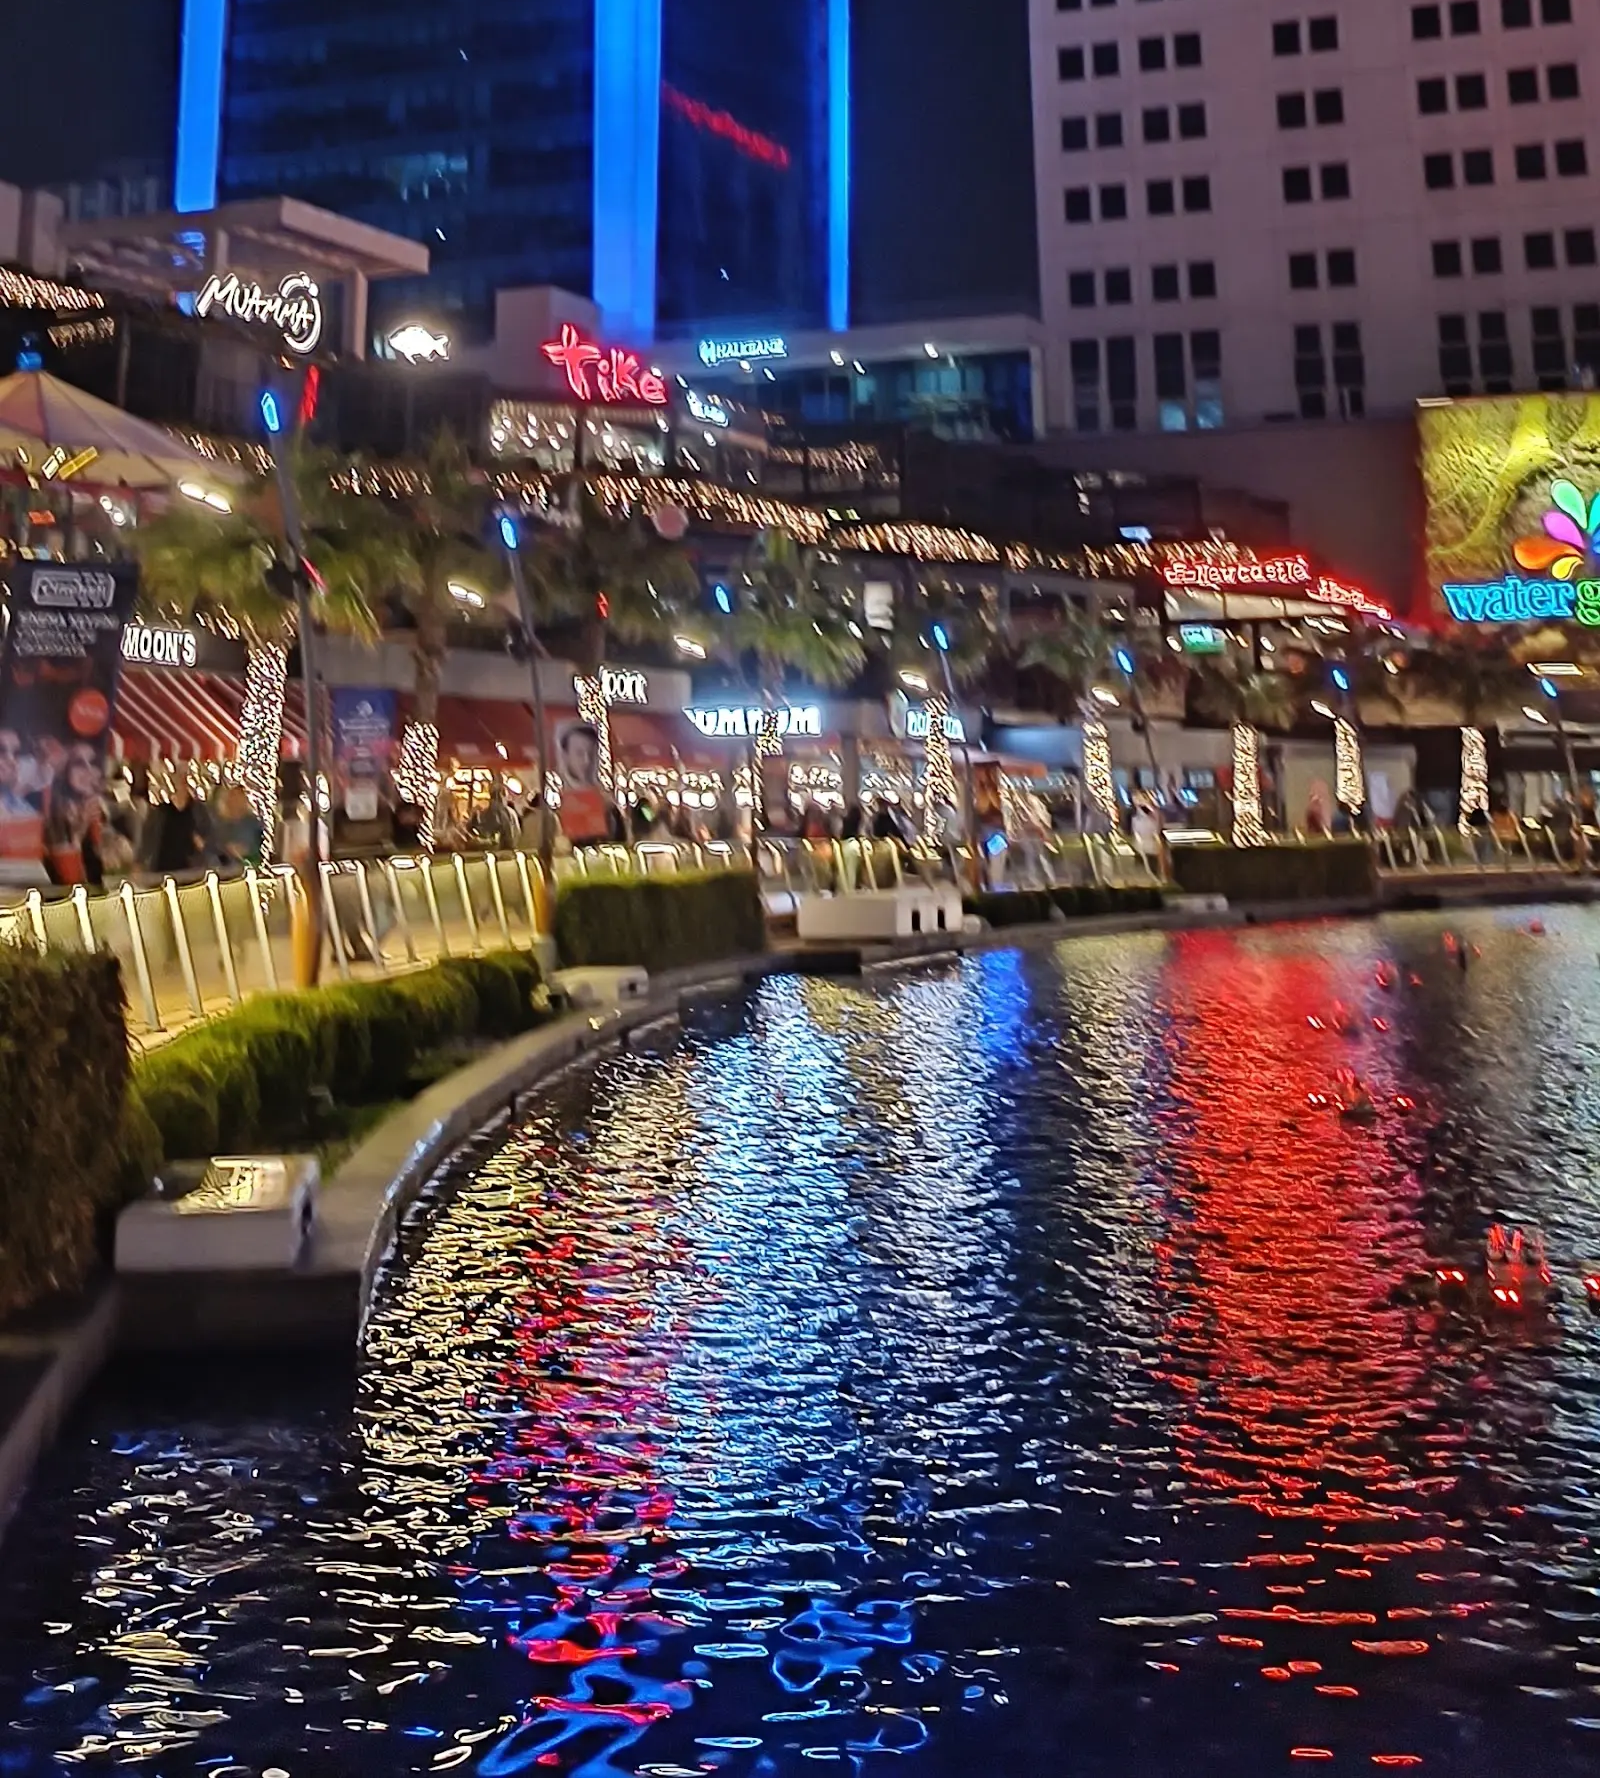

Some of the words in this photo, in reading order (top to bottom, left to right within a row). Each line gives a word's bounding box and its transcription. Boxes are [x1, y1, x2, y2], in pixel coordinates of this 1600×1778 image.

[196, 272, 315, 336] MUAMMA
[1195, 556, 1312, 588] Newcastle
[121, 623, 196, 667] MOON'S
